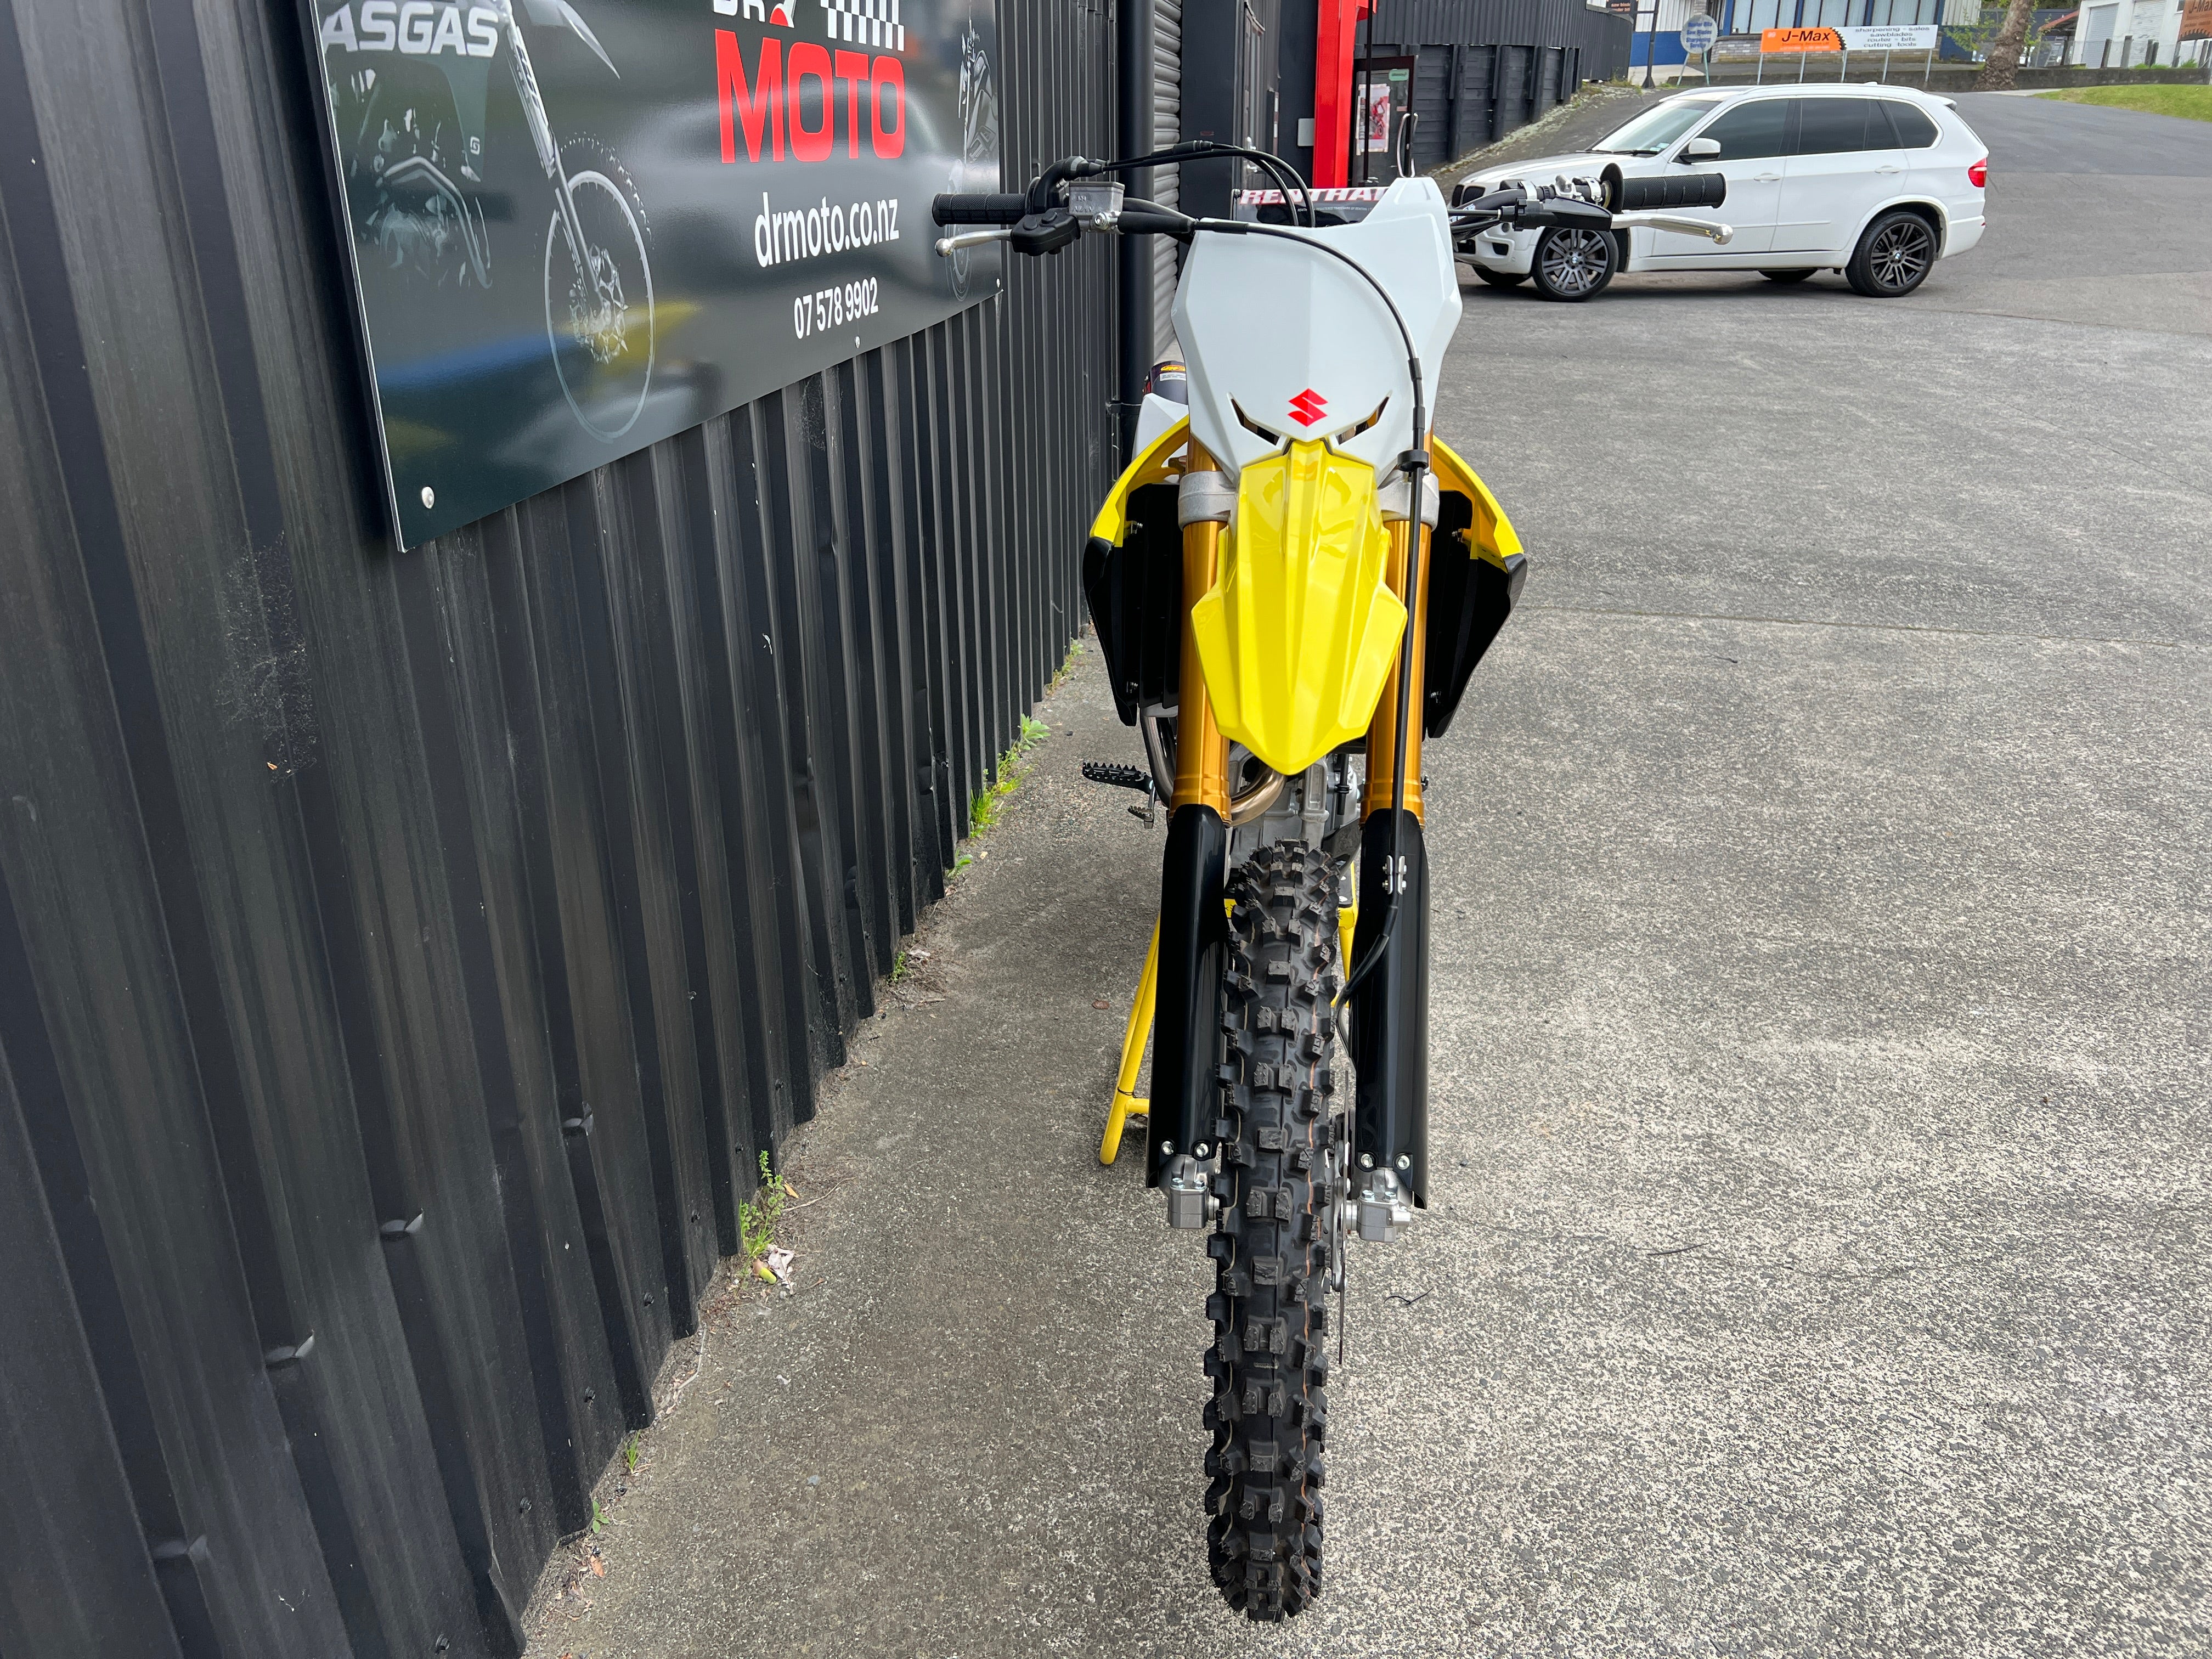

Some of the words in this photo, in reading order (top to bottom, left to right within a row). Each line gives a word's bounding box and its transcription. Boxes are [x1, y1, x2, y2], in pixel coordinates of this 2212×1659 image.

[1782, 31, 1831, 42] J-Max
[715, 29, 905, 163] MOTO
[755, 192, 899, 267] drmoto.co.nz
[794, 294, 812, 338] 07
[816, 286, 843, 331] 578
[845, 276, 878, 321] 9902
